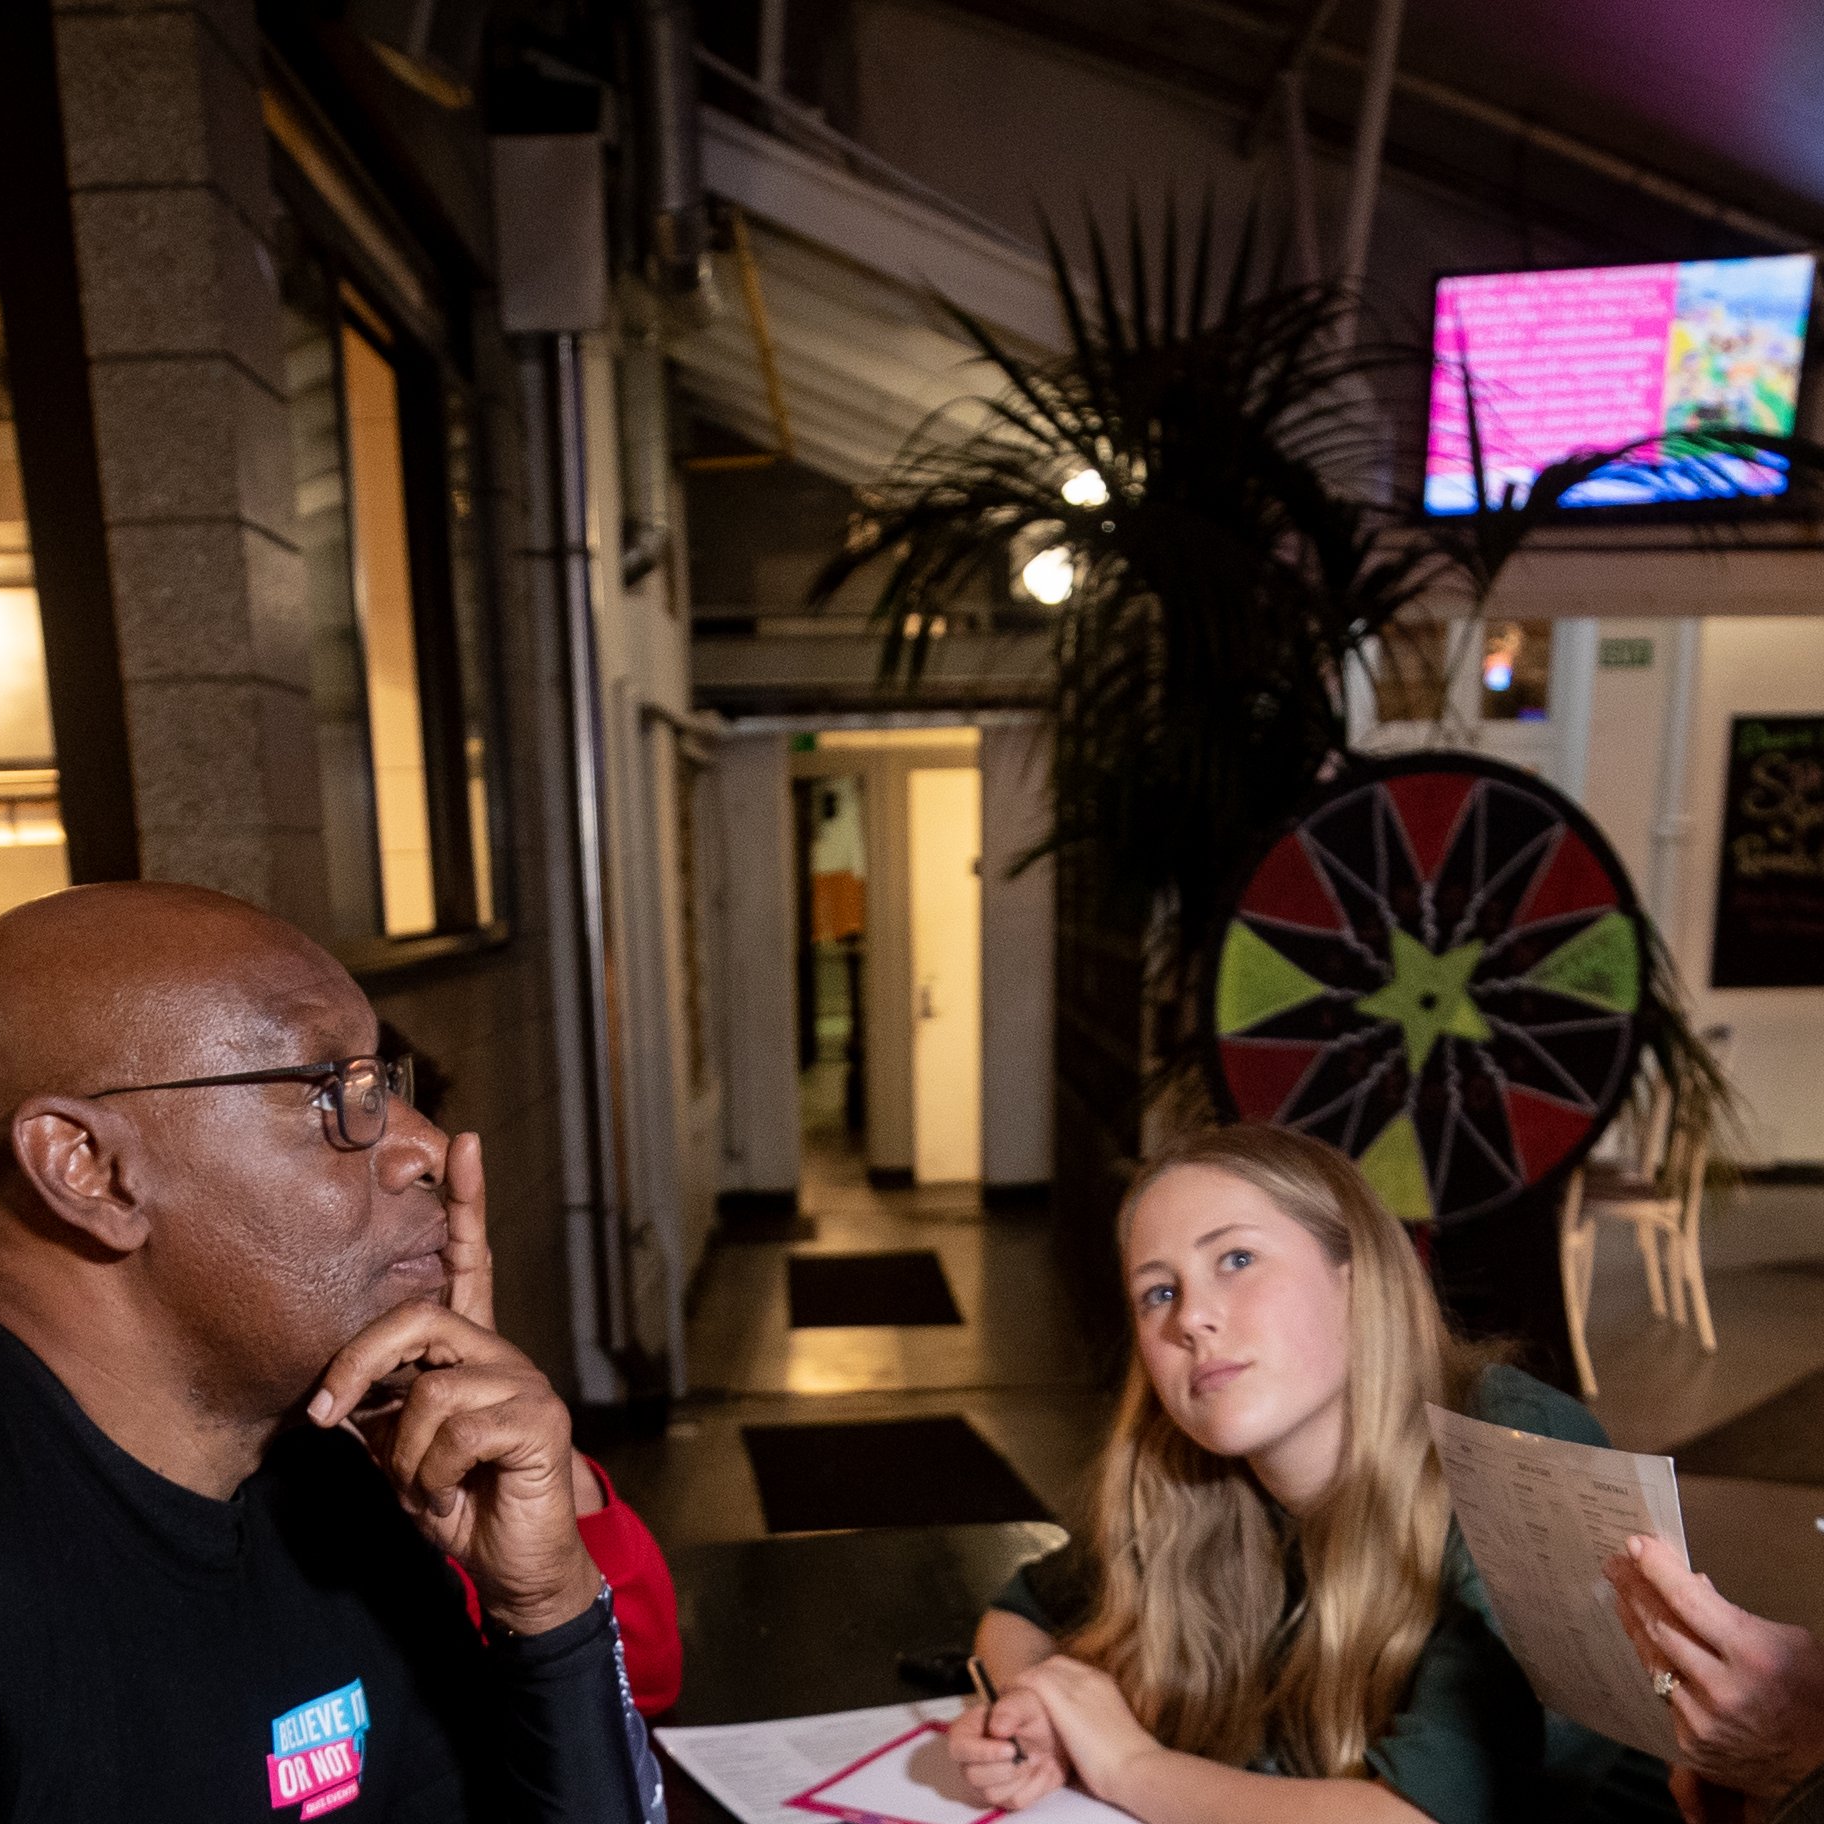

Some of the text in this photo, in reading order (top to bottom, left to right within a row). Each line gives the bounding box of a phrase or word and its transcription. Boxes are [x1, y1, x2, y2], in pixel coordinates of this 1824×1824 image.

[278, 1697, 351, 1753] BELIEVE
[277, 1741, 354, 1799] OR NOT
